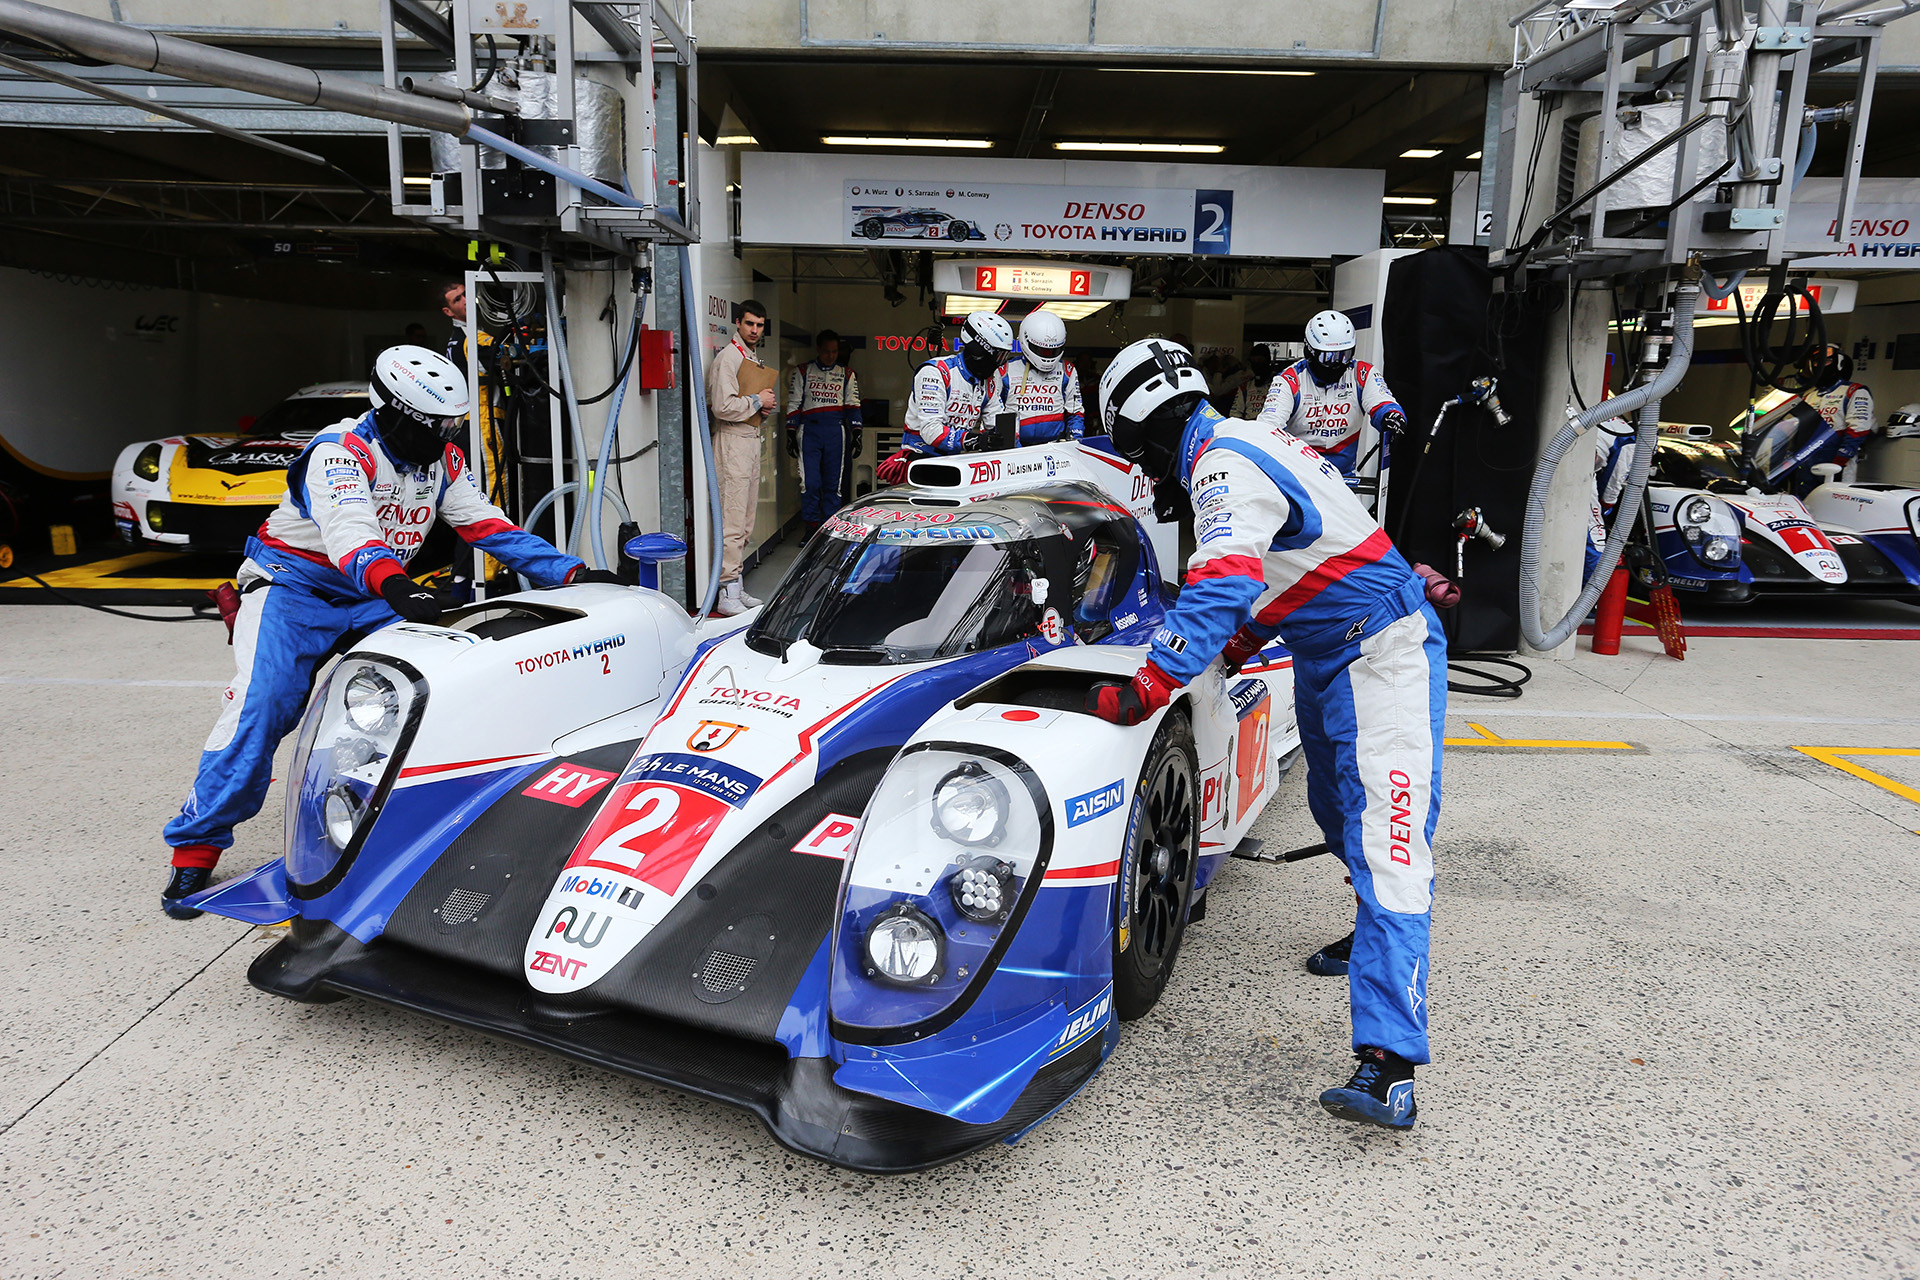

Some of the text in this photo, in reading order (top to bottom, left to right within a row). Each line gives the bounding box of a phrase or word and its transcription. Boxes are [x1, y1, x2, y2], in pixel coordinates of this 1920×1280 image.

[967, 191, 990, 199] Conway
[1064, 202, 1146, 221] DENSO
[931, 228, 936, 236] 2
[1200, 204, 1225, 242] 2
[1021, 224, 1187, 243] TOYOTA HYBRID
[274, 243, 291, 252] 50
[982, 270, 992, 288] 2
[1074, 274, 1085, 292] 2
[708, 296, 727, 319] DENSO
[974, 334, 996, 356] uvex
[1031, 338, 1048, 347] TOYOTA
[392, 360, 446, 404] TOYOTA HYBRID
[809, 382, 841, 392] DENSO
[1014, 385, 1058, 395] DENSO
[390, 398, 435, 428] uvex
[1306, 403, 1350, 418] DENSO
[1306, 428, 1347, 437] HYBRID
[1308, 418, 1348, 430] TOYOTA
[325, 458, 360, 468] JTEKT
[968, 460, 1001, 485] ZENT
[1016, 463, 1032, 474] AISIN
[1033, 462, 1042, 472] AW
[1198, 486, 1226, 504] AISIN
[1850, 496, 1874, 504] HYBRID
[850, 506, 955, 523] DENSO
[380, 526, 423, 546] YOTA
[877, 526, 996, 540] HYBRID
[1797, 528, 1823, 548] 1
[1660, 576, 1706, 588] CHELIN
[515, 633, 626, 675] TOYOTA HYBRID
[601, 654, 611, 675] 2
[710, 687, 800, 710] TOYOTA
[1242, 691, 1253, 704] LE
[1248, 680, 1265, 698] MANS
[747, 702, 793, 718] Racing
[1252, 713, 1266, 794] 2
[532, 768, 609, 799] HY
[627, 756, 749, 796] 24h LE MANS
[724, 788, 740, 801] 2015
[1072, 785, 1122, 822] AISIN
[1202, 772, 1223, 822] P1
[1389, 770, 1411, 866] DENSO
[587, 787, 680, 870] 2
[808, 821, 854, 852] P
[1123, 800, 1143, 903] MICHELIN
[560, 876, 619, 900] Mobil
[530, 950, 587, 980] ZENT
